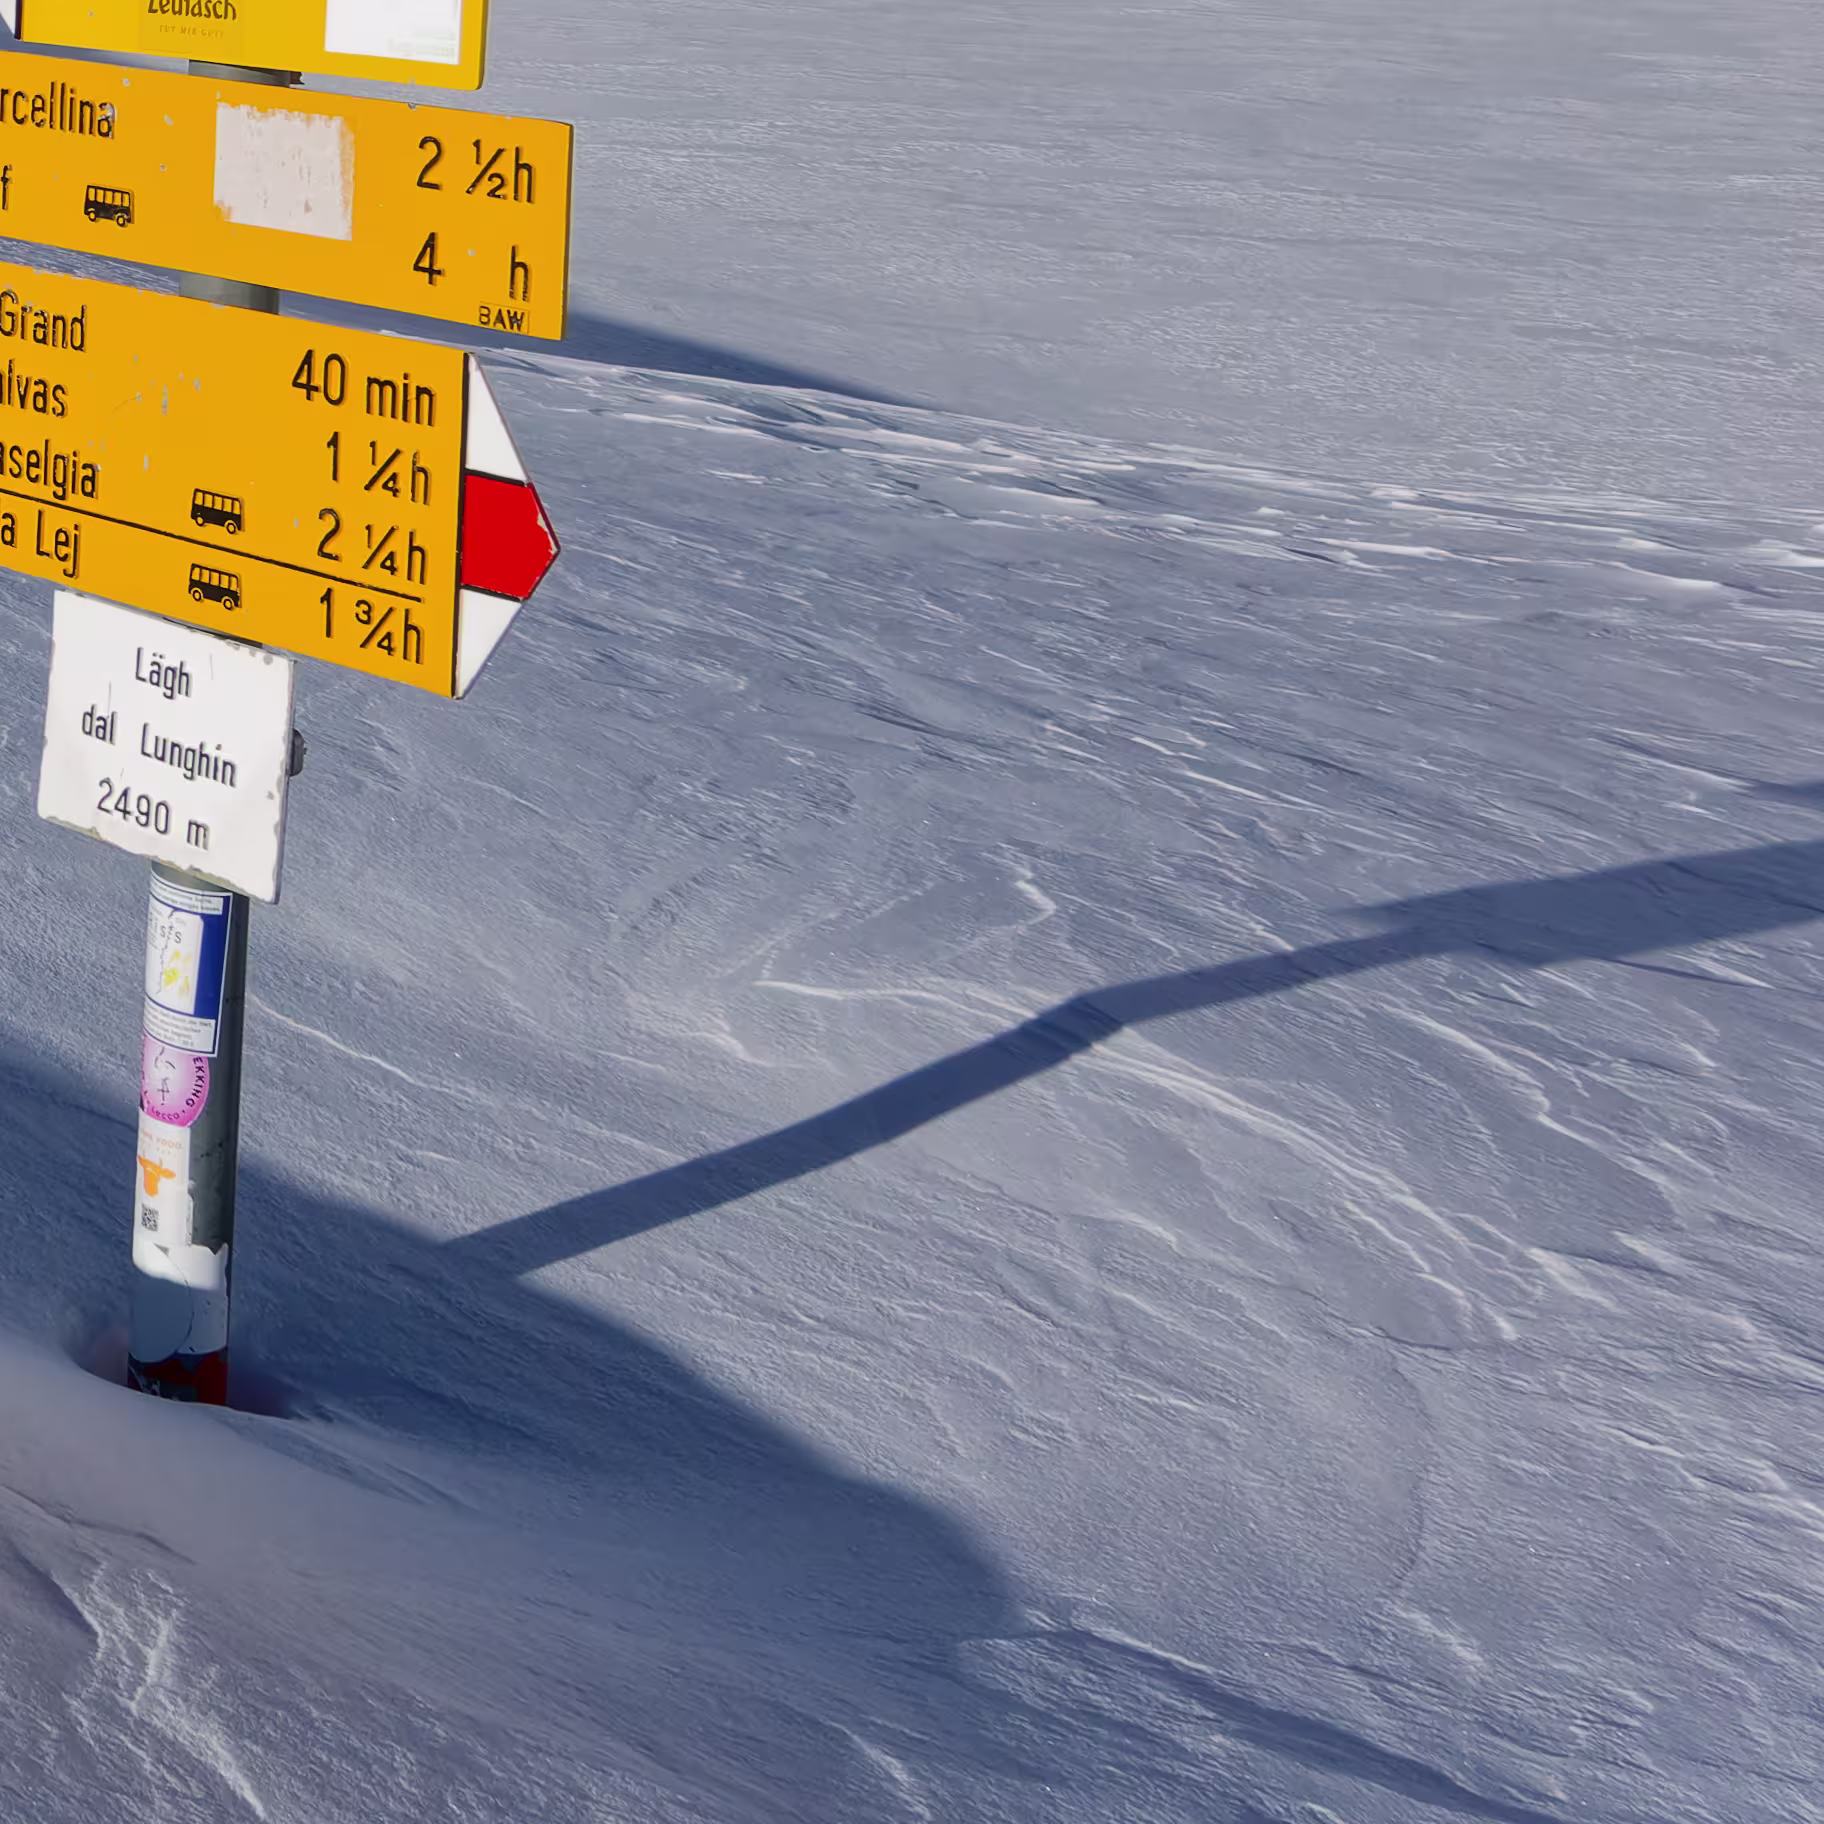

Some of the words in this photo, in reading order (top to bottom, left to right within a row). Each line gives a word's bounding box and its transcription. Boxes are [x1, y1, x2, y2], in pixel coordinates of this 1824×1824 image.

[416, 135, 443, 191] 2
[412, 231, 443, 286] 4
[509, 245, 530, 302] h
[478, 306, 525, 333] BAW
[291, 349, 347, 407] 40
[365, 372, 435, 427] min
[326, 431, 340, 483] 1
[316, 507, 342, 562] 2
[35, 509, 81, 579] Lej
[319, 587, 334, 640] 1
[135, 647, 191, 701] Lägh
[81, 704, 117, 745] dal
[140, 722, 237, 788] Lunghin
[96, 777, 171, 837] 2490
[186, 818, 210, 851] m
